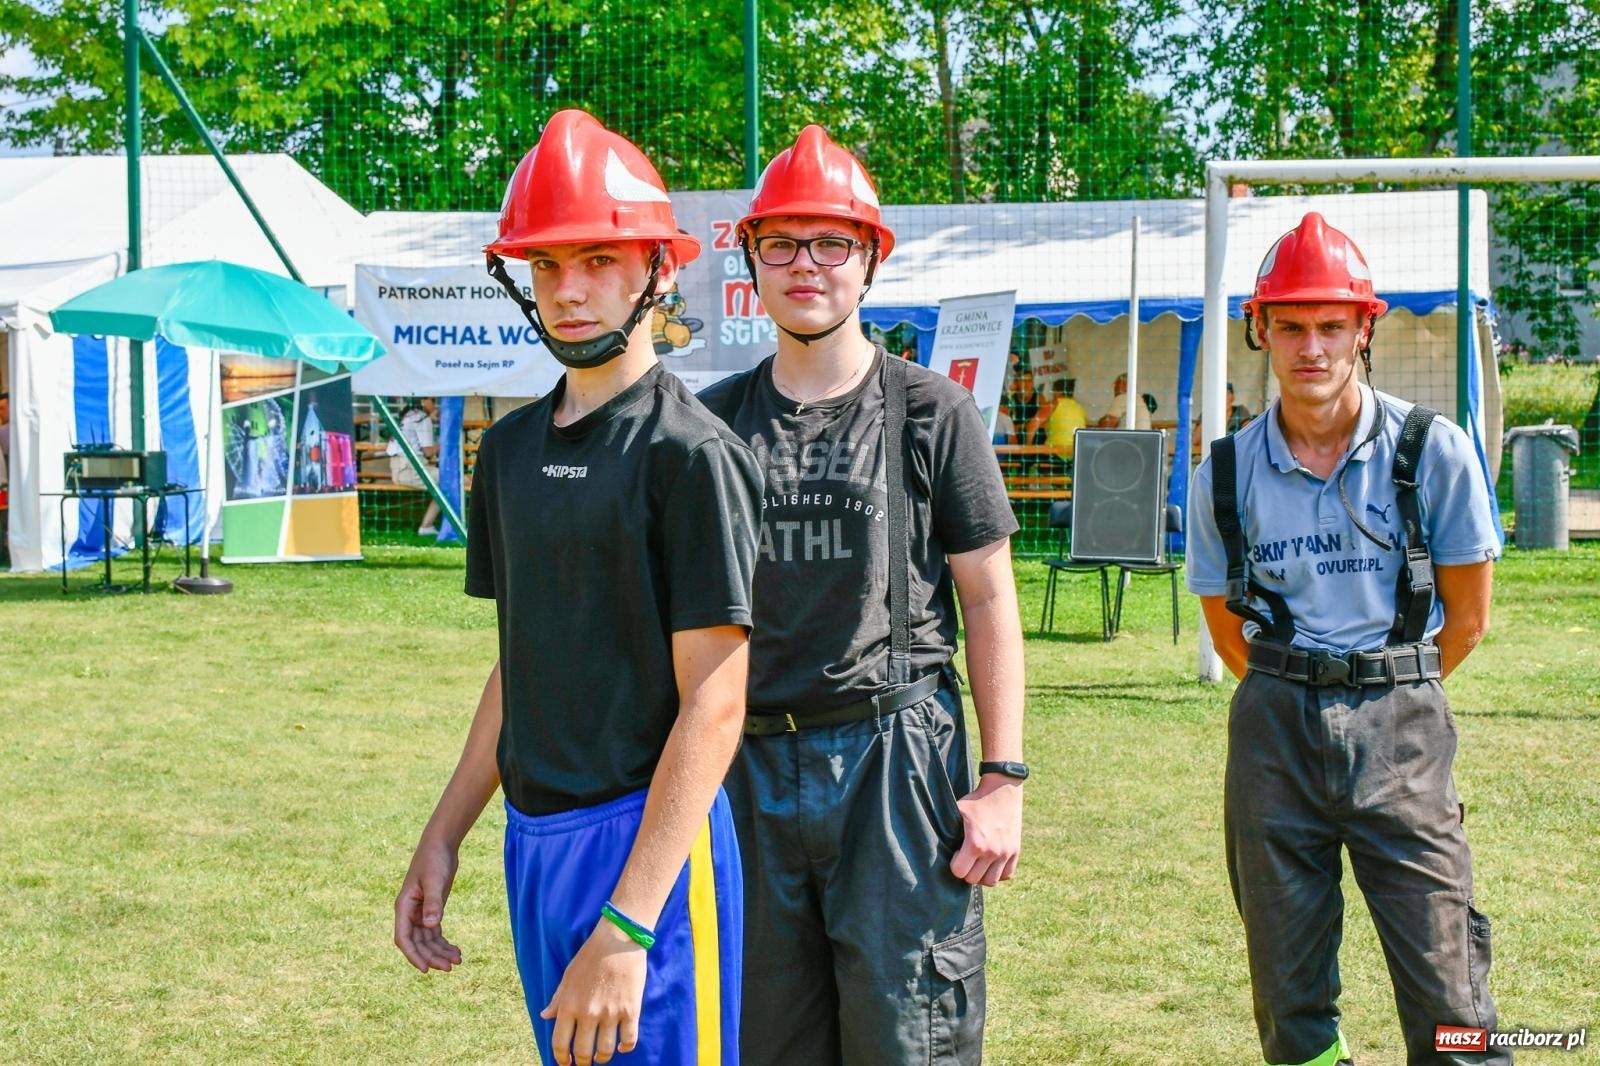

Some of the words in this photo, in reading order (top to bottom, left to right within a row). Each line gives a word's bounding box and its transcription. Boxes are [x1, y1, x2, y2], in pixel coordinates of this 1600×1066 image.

[378, 286, 466, 300] PATRONAT
[470, 286, 532, 300] HONR
[955, 311, 988, 323] GMINA
[393, 325, 492, 345] MICHAŁ
[435, 360, 461, 369] Poseł
[463, 361, 475, 369] na
[477, 360, 499, 371] Sejm
[502, 360, 515, 369] RP
[546, 464, 588, 479] KIPSTA
[844, 498, 885, 522] 1902
[757, 518, 853, 563] ATHL
